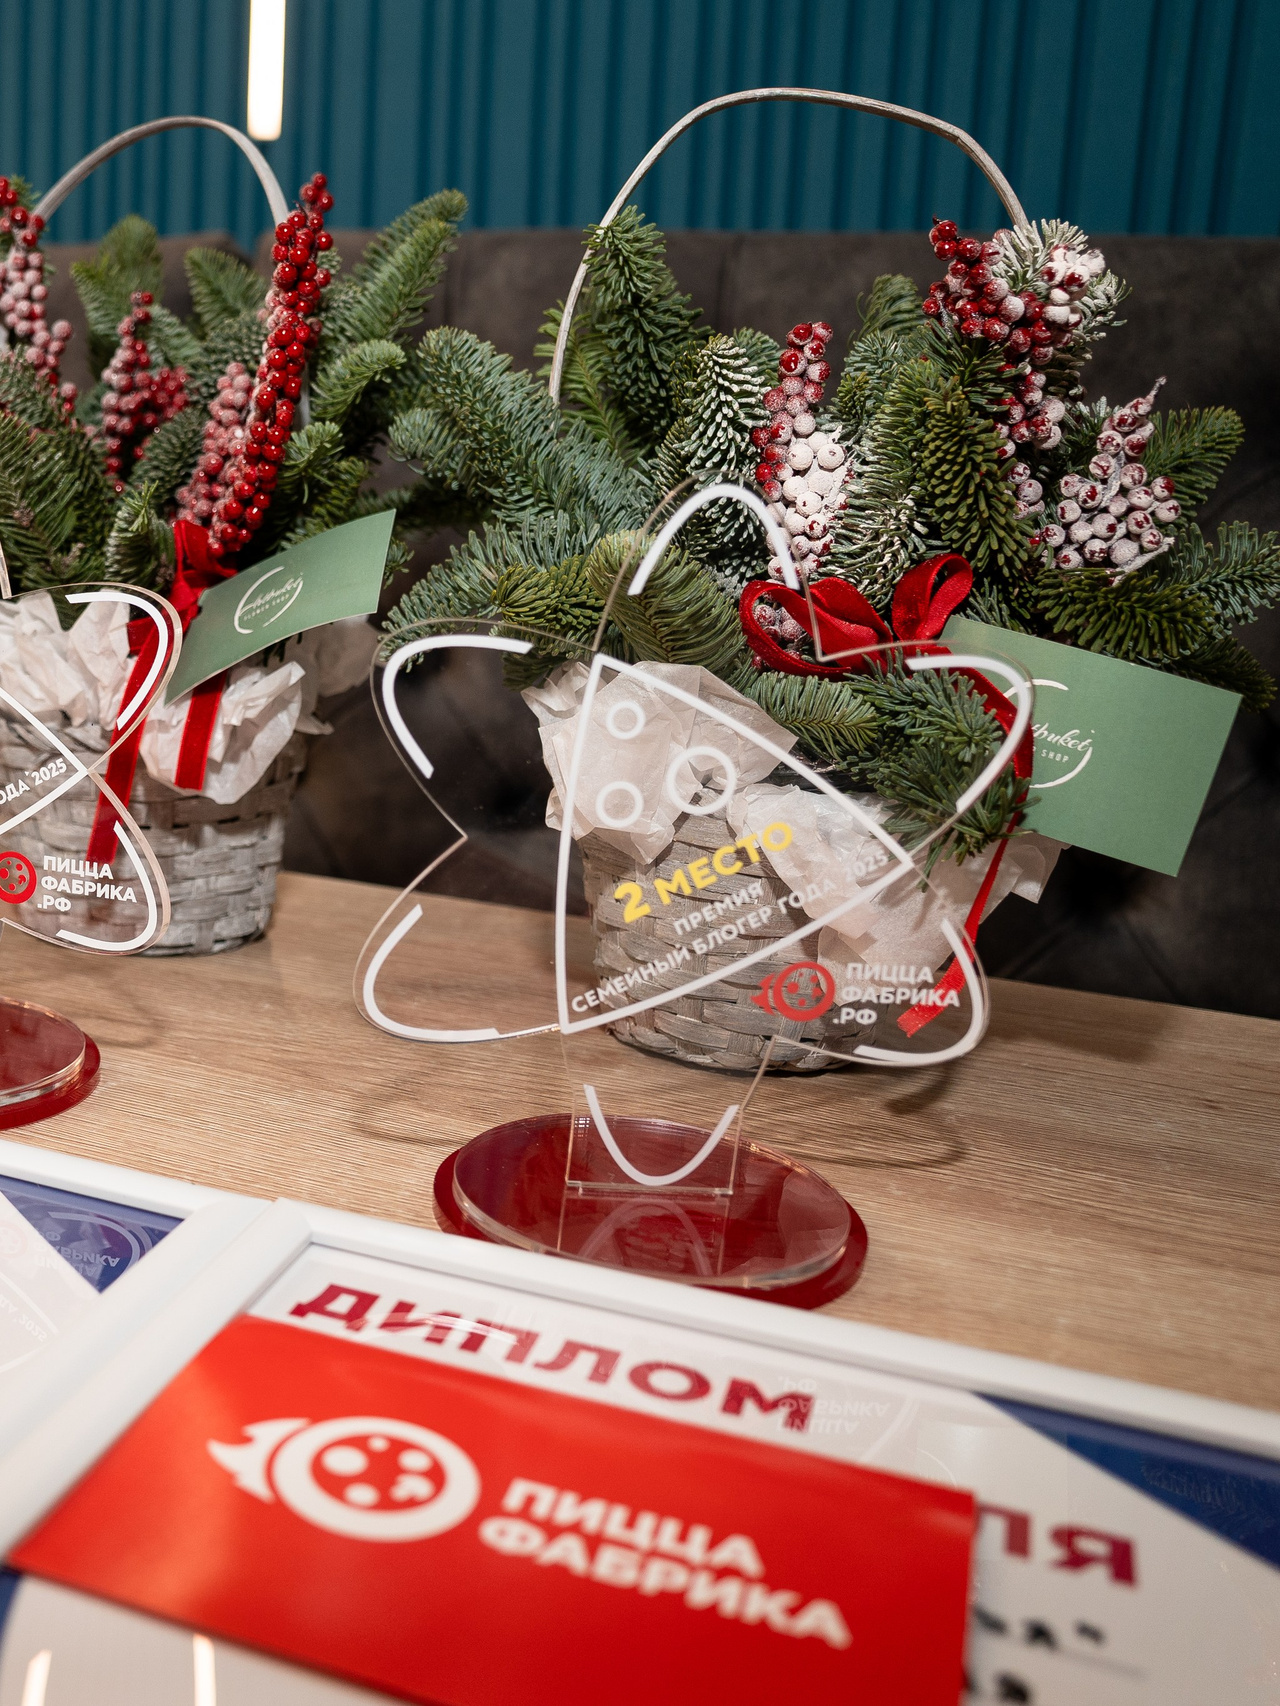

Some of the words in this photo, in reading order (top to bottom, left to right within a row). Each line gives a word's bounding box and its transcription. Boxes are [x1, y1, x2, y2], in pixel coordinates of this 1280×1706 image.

[1041, 749, 1069, 763] SHOP
[43, 855, 114, 880] ПИЦЦА
[614, 882, 651, 924] 2
[654, 822, 793, 907] МЕСТО
[36, 895, 72, 913] .РФ
[40, 876, 138, 904] ФАБРИКА
[672, 881, 764, 936] ПРЕМИЯ
[571, 944, 691, 1013] СЕМЕЙНЫЙ
[692, 906, 773, 956] БЛОГЕР
[778, 879, 837, 915] ГОДА
[845, 963, 933, 984] ПИЦЦА
[841, 985, 961, 1008] ФАБРИКА
[832, 1008, 878, 1026] .РФ
[289, 1283, 817, 1433] ДИПЛОМ
[502, 1477, 765, 1580] ПИЦЦА
[478, 1515, 854, 1650] ФАБРИКА
